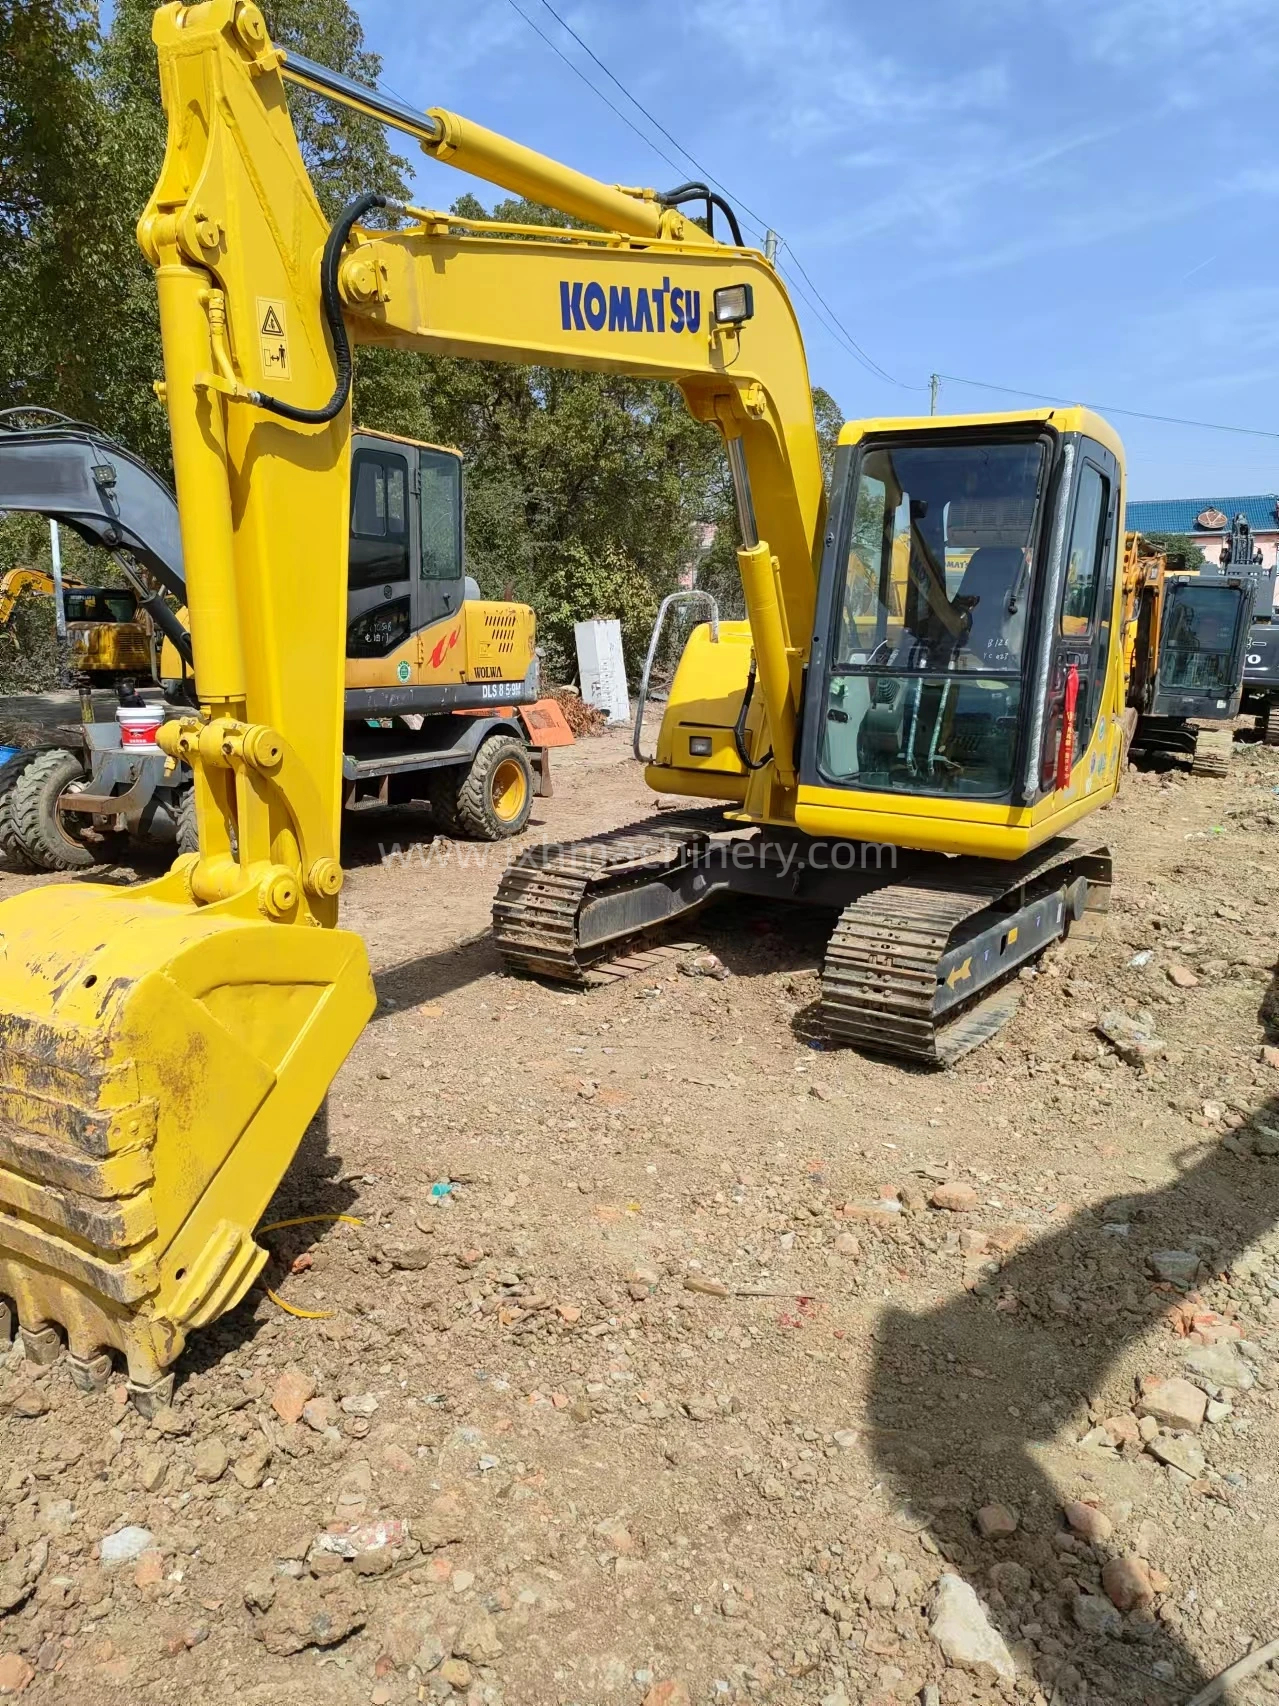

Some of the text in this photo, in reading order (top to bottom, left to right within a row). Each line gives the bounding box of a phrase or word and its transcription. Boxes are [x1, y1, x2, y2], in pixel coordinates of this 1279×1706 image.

[559, 276, 700, 333] KOMATSU
[473, 666, 503, 679] WOLWA
[482, 684, 498, 698] DLS
